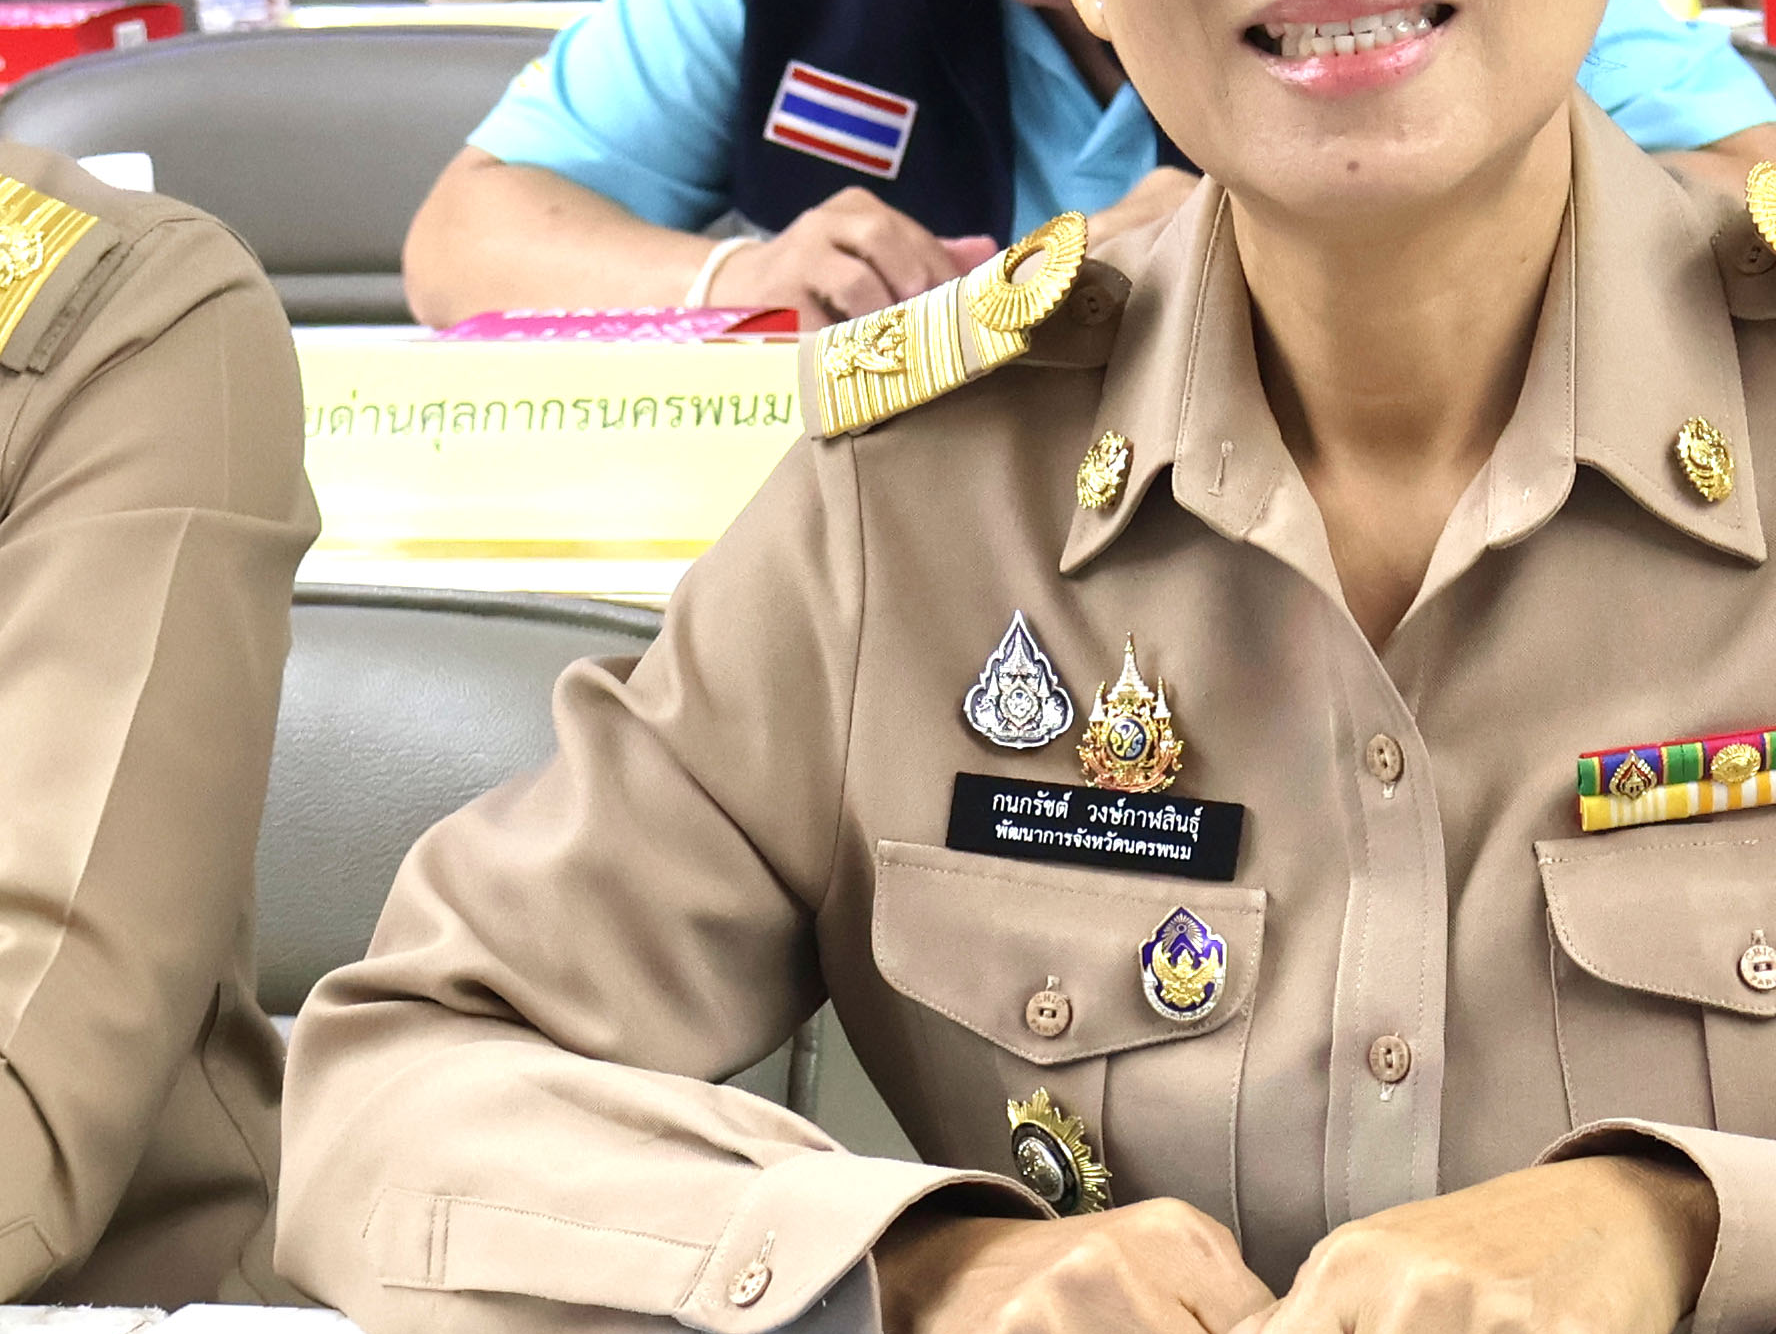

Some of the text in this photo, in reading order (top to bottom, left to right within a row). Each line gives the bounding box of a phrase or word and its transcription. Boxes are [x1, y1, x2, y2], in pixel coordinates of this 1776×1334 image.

[995, 819, 1192, 861] พัฒนาการจังหวัดนครพนม
